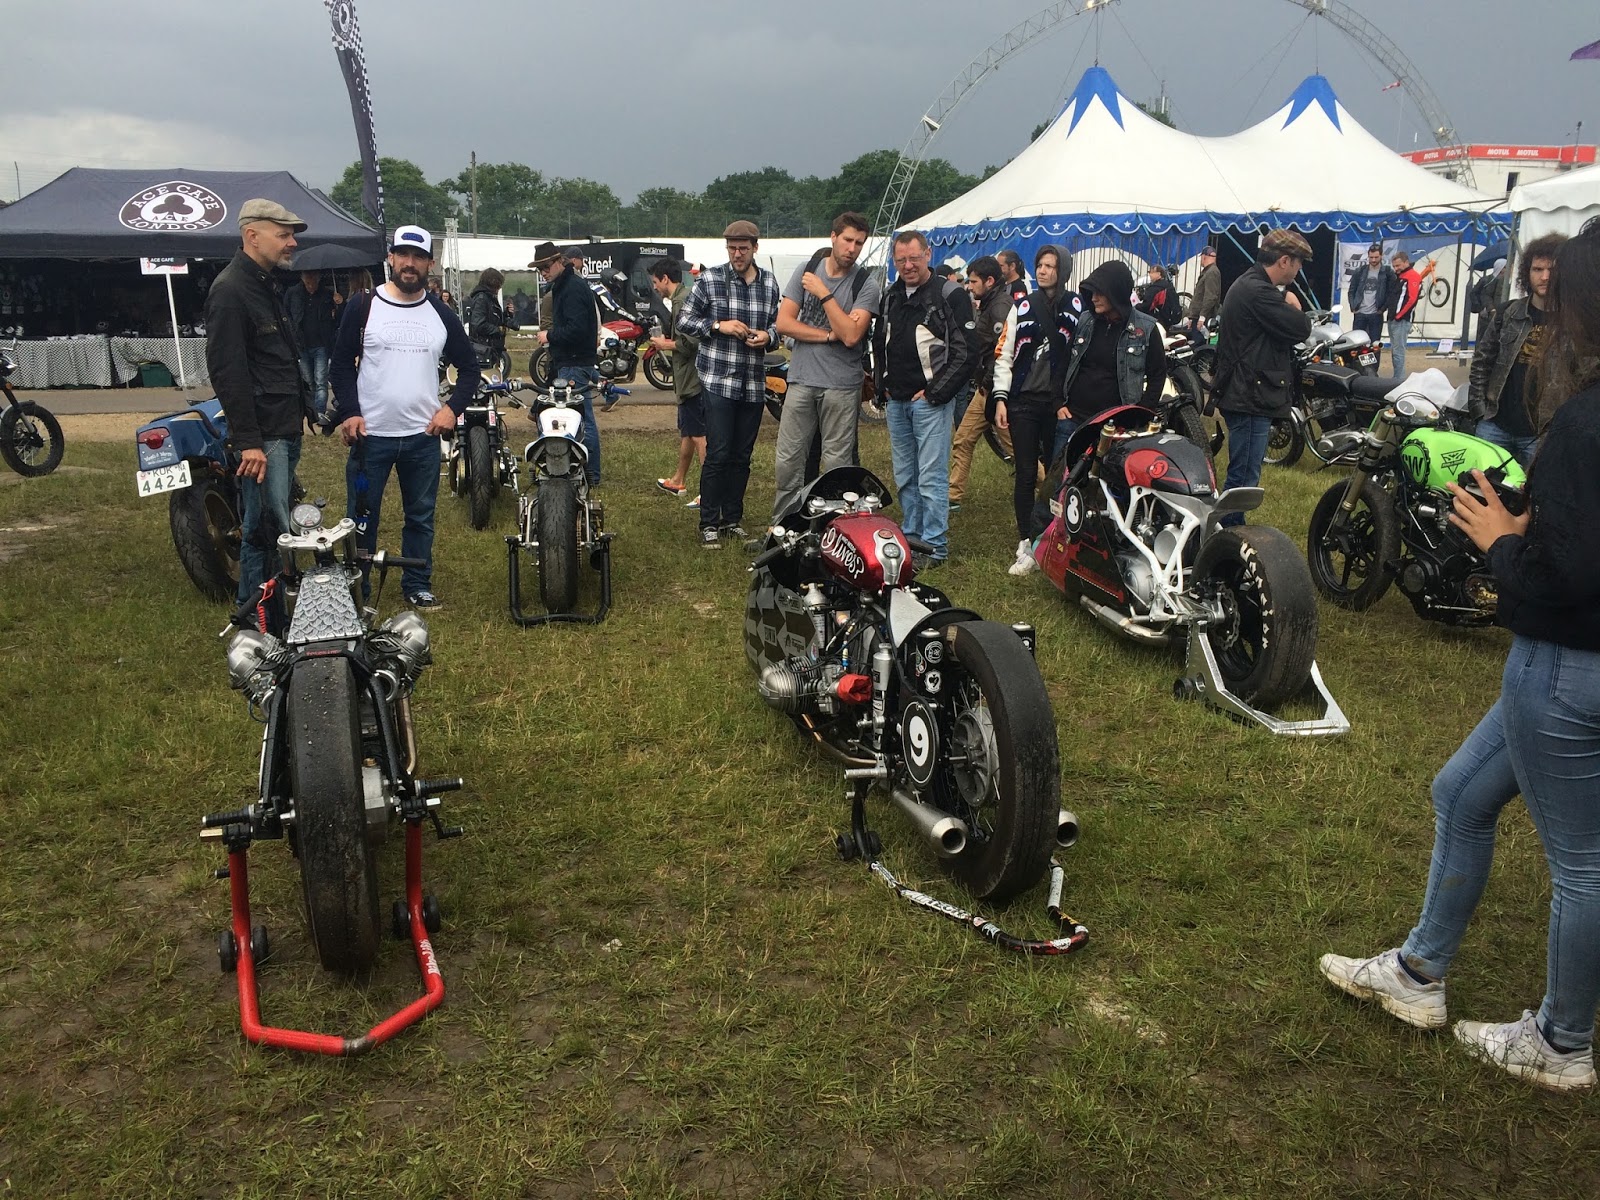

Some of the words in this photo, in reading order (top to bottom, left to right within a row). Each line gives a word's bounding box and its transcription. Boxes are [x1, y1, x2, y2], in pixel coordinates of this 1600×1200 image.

[1424, 152, 1439, 160] MOTUL
[1487, 148, 1510, 156] MOTUL
[1517, 149, 1540, 157] MOTUL
[131, 186, 170, 209] ACE
[176, 184, 221, 210] CAFE
[128, 216, 213, 230] LONDON
[581, 255, 613, 278] Street
[385, 330, 428, 344] SHOEI
[142, 472, 188, 493] 4424
[1066, 495, 1080, 525] 8
[909, 715, 930, 767] 9
